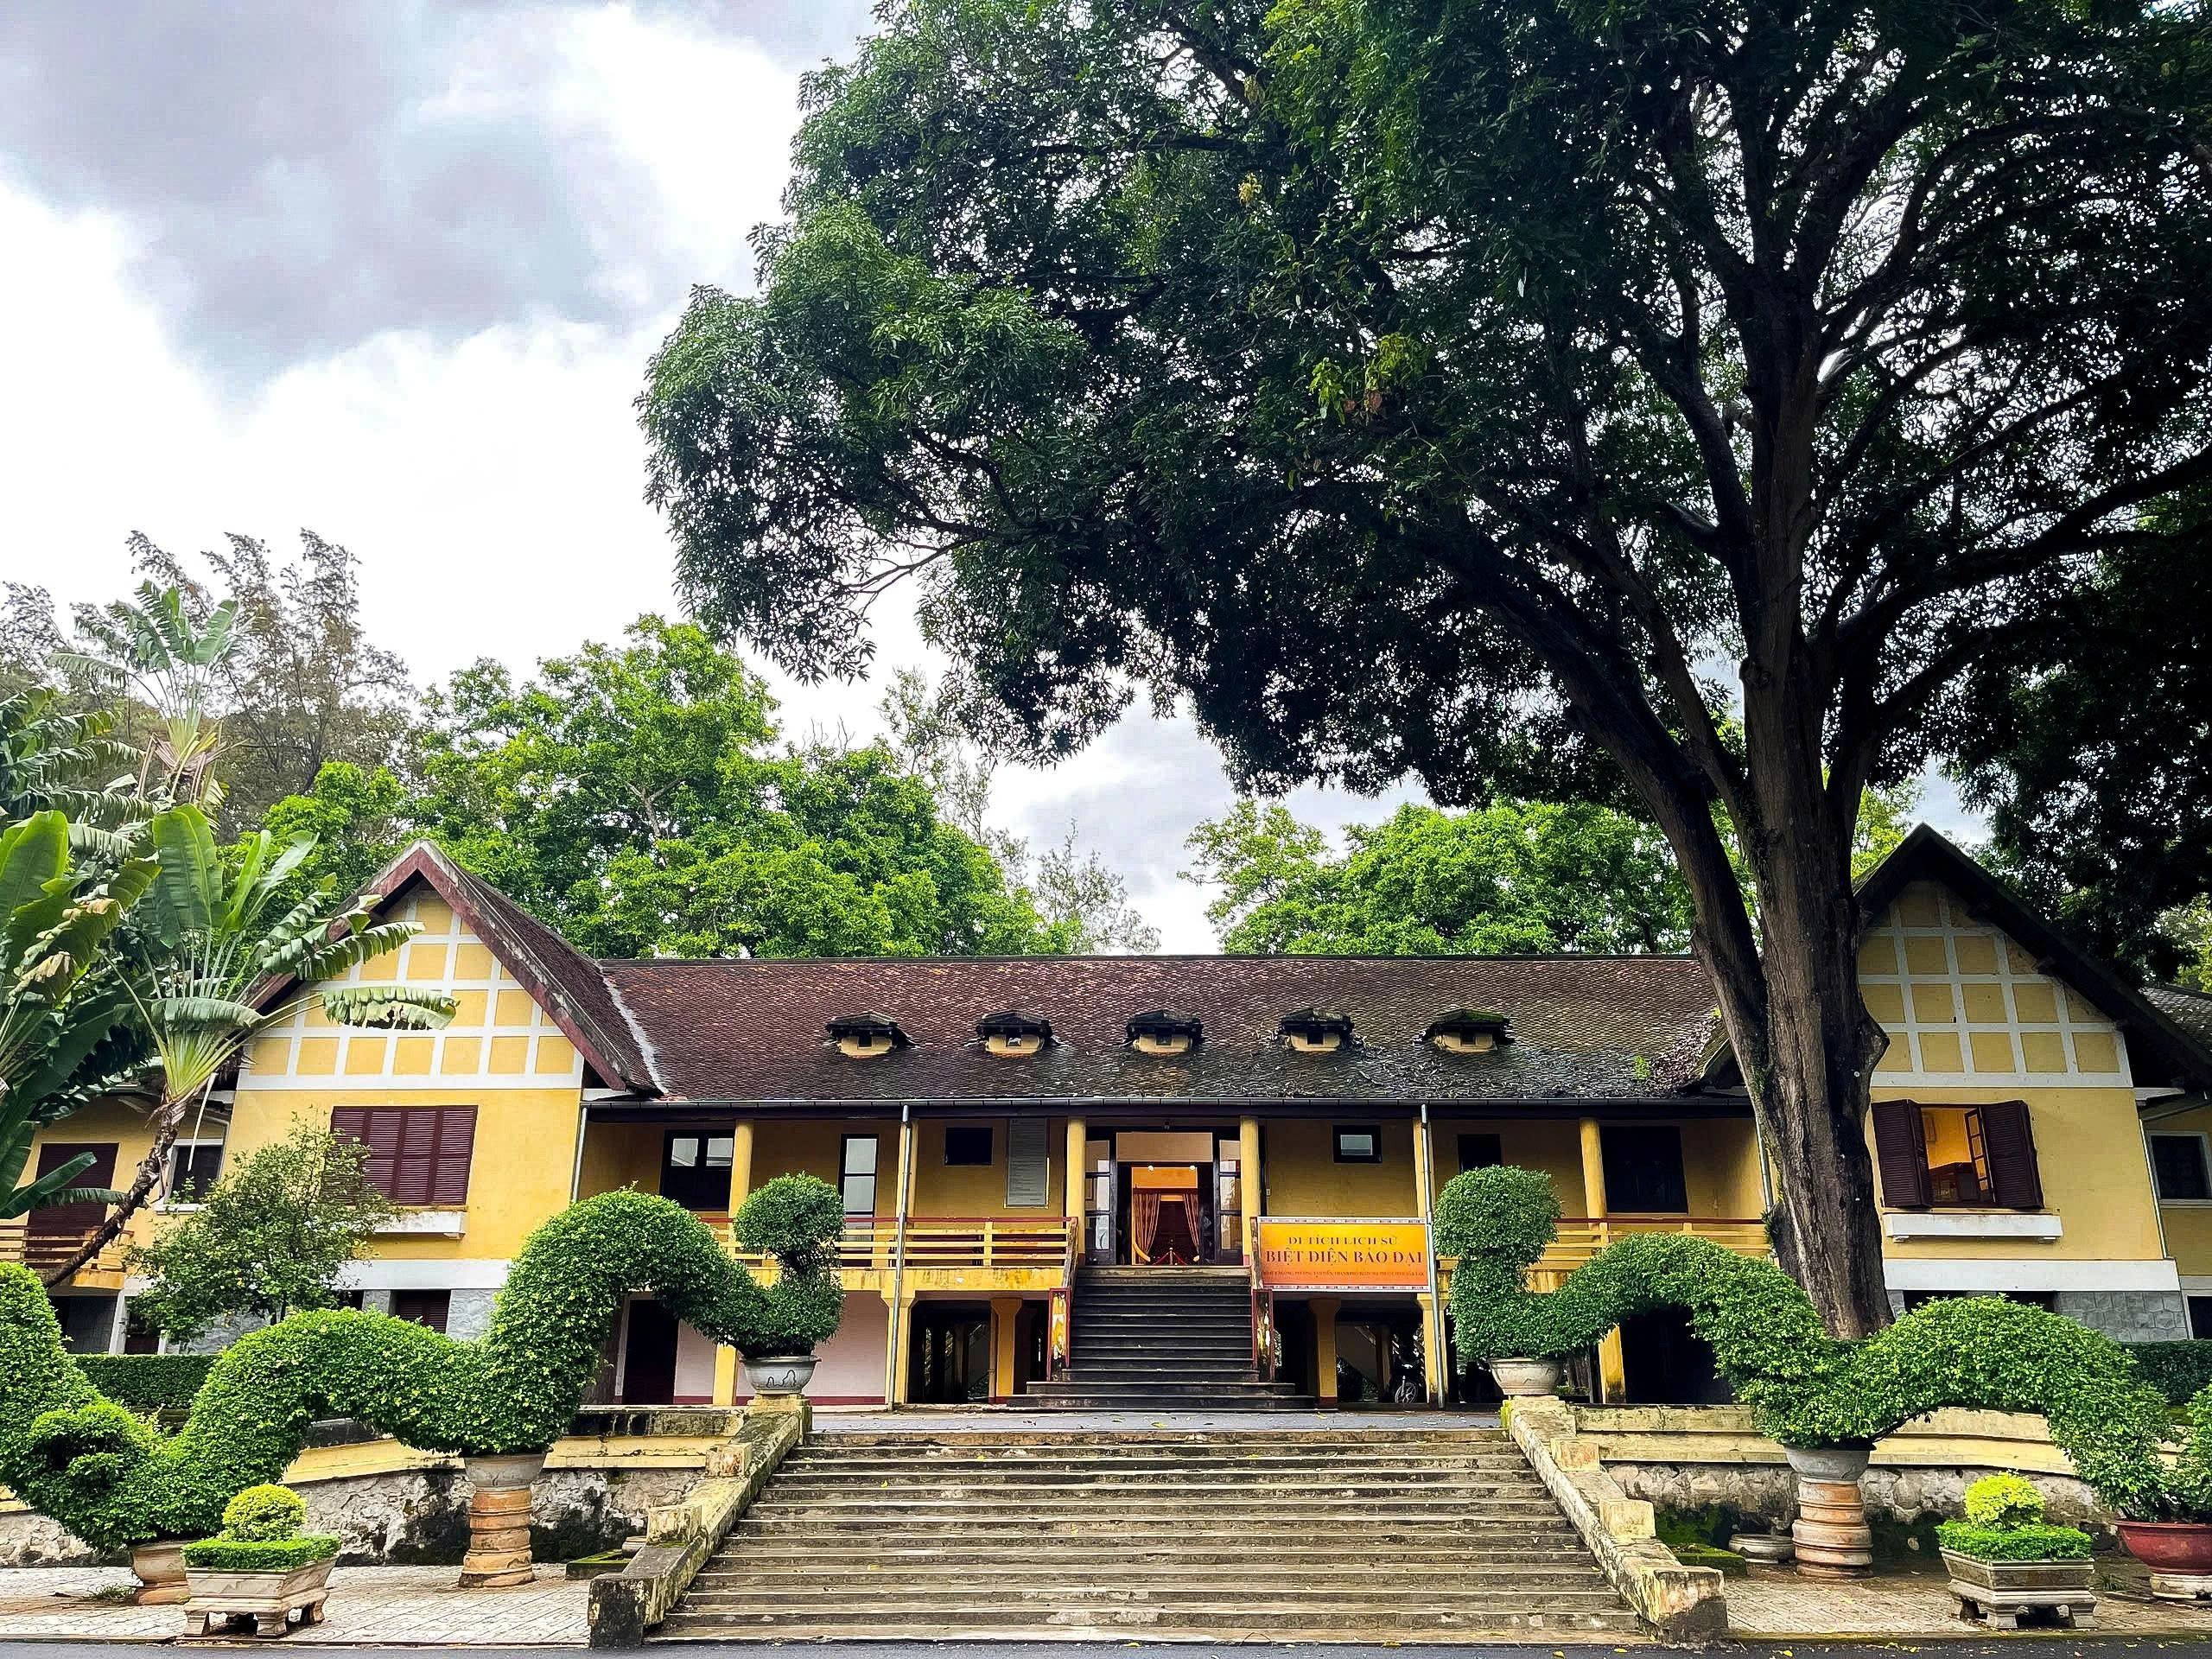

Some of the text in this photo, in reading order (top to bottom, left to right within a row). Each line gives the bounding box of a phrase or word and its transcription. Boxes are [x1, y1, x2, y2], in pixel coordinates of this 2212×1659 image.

[1266, 1247, 1304, 1266] BIỆT
[1309, 1247, 1348, 1266] DIỆN
[1354, 1247, 1388, 1263] BẢO
